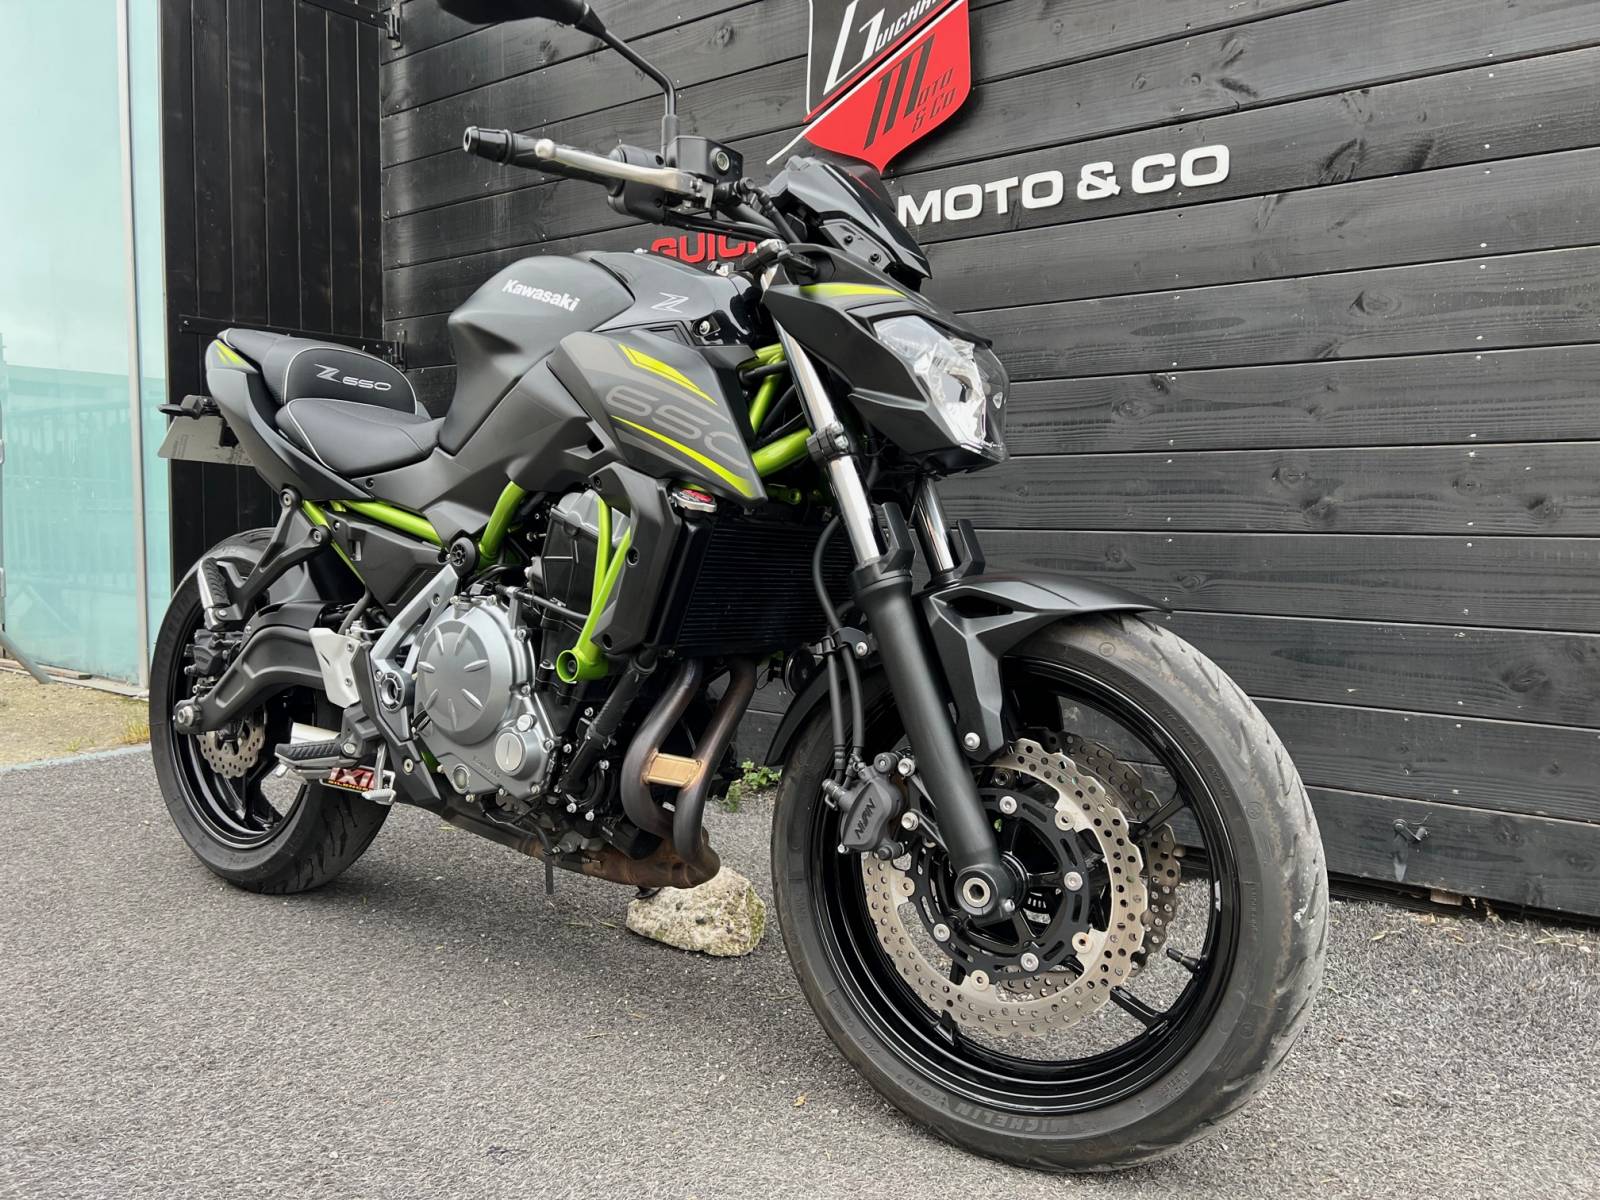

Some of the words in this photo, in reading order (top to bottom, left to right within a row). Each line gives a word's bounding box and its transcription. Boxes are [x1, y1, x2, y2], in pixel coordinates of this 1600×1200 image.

[898, 170, 1065, 227] MOTO
[1076, 161, 1121, 200] &
[1131, 144, 1230, 194] CO
[502, 279, 580, 312] Kawasaki
[650, 292, 689, 313] Z
[313, 363, 341, 383] Z
[342, 376, 392, 391] 650
[954, 1102, 1069, 1133] MICHELIN
